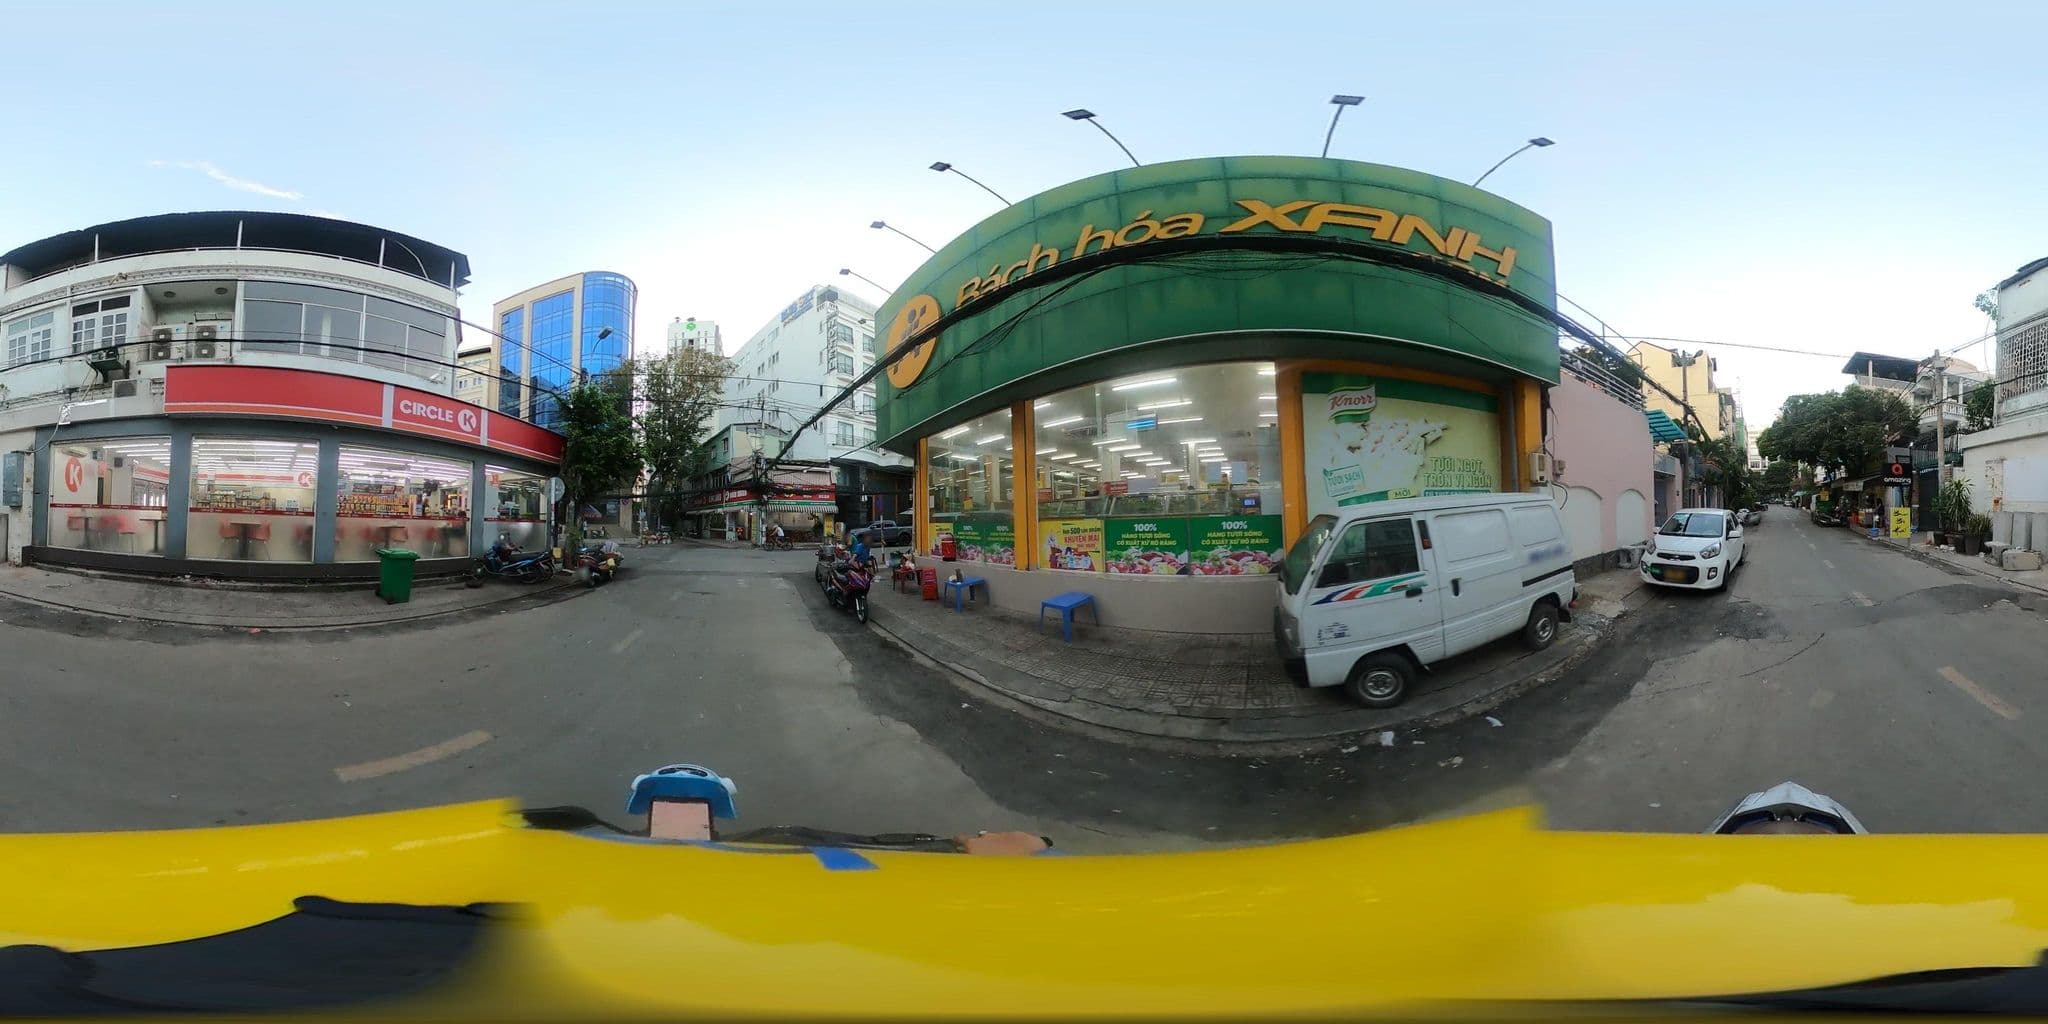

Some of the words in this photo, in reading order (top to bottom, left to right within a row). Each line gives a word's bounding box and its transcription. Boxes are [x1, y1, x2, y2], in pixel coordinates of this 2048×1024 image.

[1218, 200, 1517, 277] XANH
[1329, 394, 1372, 410] Knorr
[400, 400, 454, 423] CIRCLE
[1134, 523, 1157, 531] 100%
[1221, 521, 1248, 530] 100%
